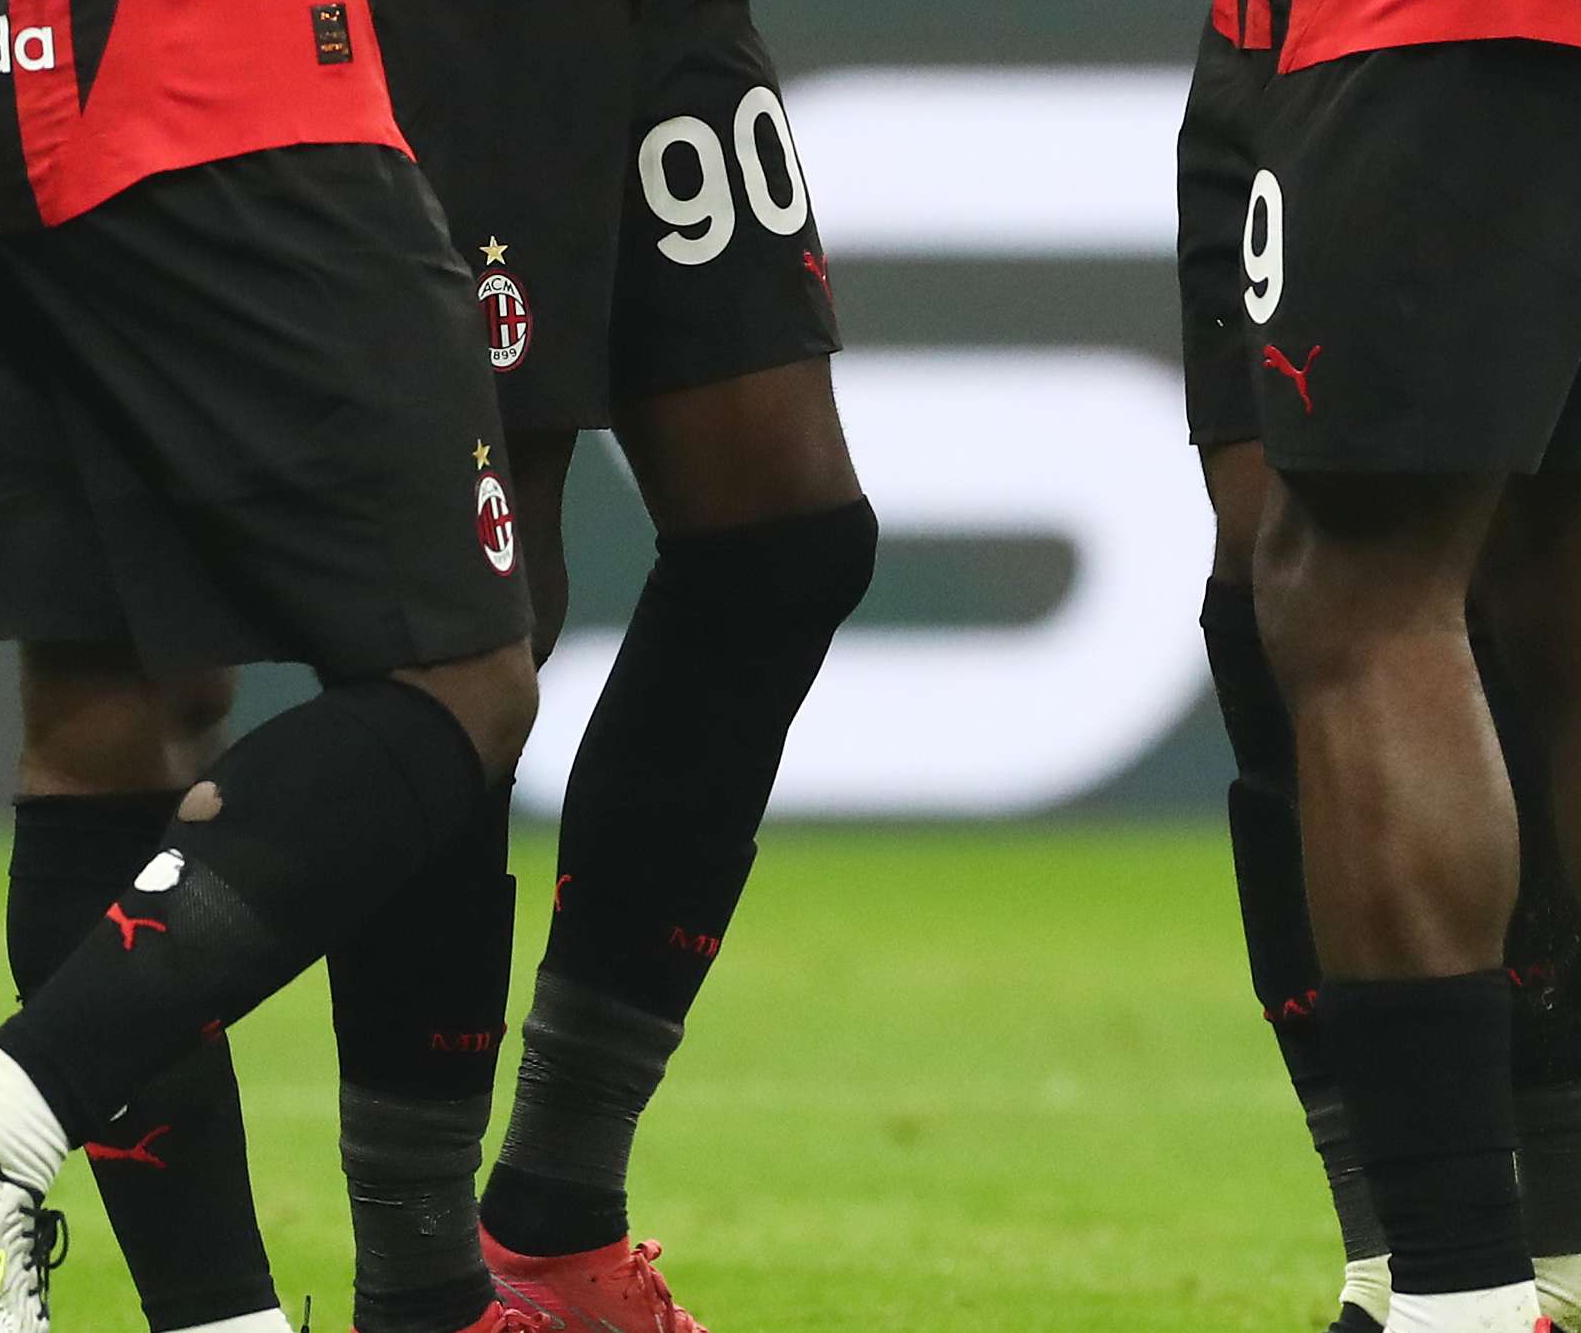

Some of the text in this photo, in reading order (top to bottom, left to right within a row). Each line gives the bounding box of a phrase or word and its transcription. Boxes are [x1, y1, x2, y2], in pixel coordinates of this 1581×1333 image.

[637, 85, 809, 266] 90
[481, 276, 517, 296] ACM
[1242, 168, 1284, 325] 9
[490, 347, 518, 362] 899
